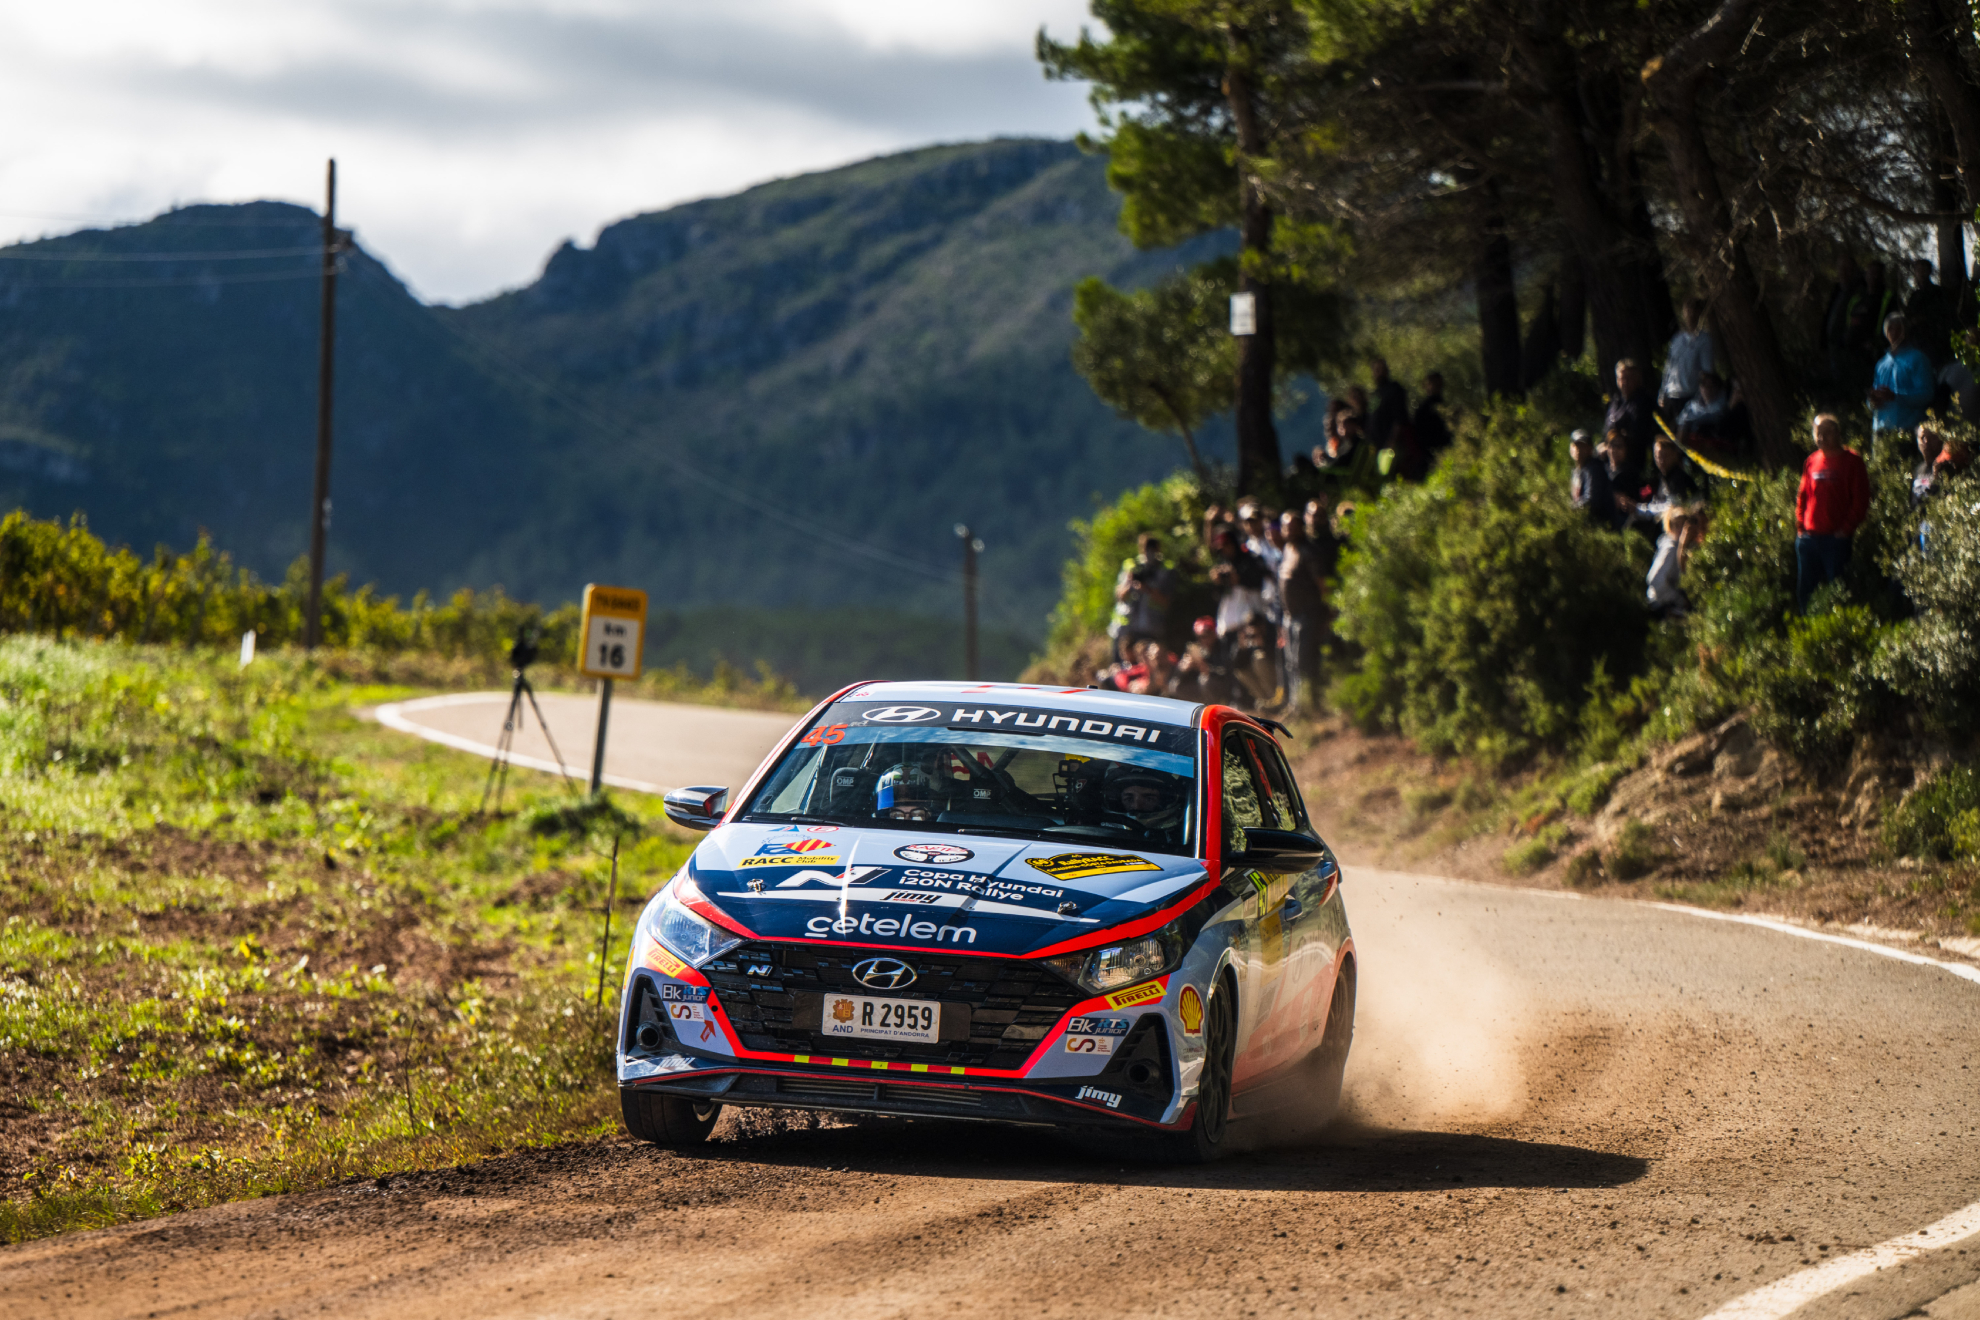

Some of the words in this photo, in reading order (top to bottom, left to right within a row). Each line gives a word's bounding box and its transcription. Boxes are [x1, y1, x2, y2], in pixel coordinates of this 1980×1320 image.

[600, 643, 624, 668] 16
[800, 724, 849, 747] 45
[952, 707, 1161, 743] HYUNDAI
[836, 777, 855, 786] OMP
[973, 789, 991, 799] OMP
[742, 857, 795, 867] RACC
[899, 876, 953, 889] i20N
[956, 882, 1024, 901] Rallye
[904, 869, 965, 881] Copa
[968, 875, 1064, 898] Hyundai
[804, 912, 977, 943] cetelem
[647, 947, 681, 973] PIRELLI
[663, 984, 682, 1000] Bk
[1112, 984, 1161, 1006] PIRELLI
[862, 1002, 875, 1026] R
[879, 1003, 933, 1031] 2959
[1067, 1018, 1096, 1033] Bk
[1098, 1018, 1130, 1028] RTS
[832, 1025, 854, 1033] AND
[860, 1028, 892, 1036] PRINCIPAT
[1074, 1085, 1123, 1108] jimy
